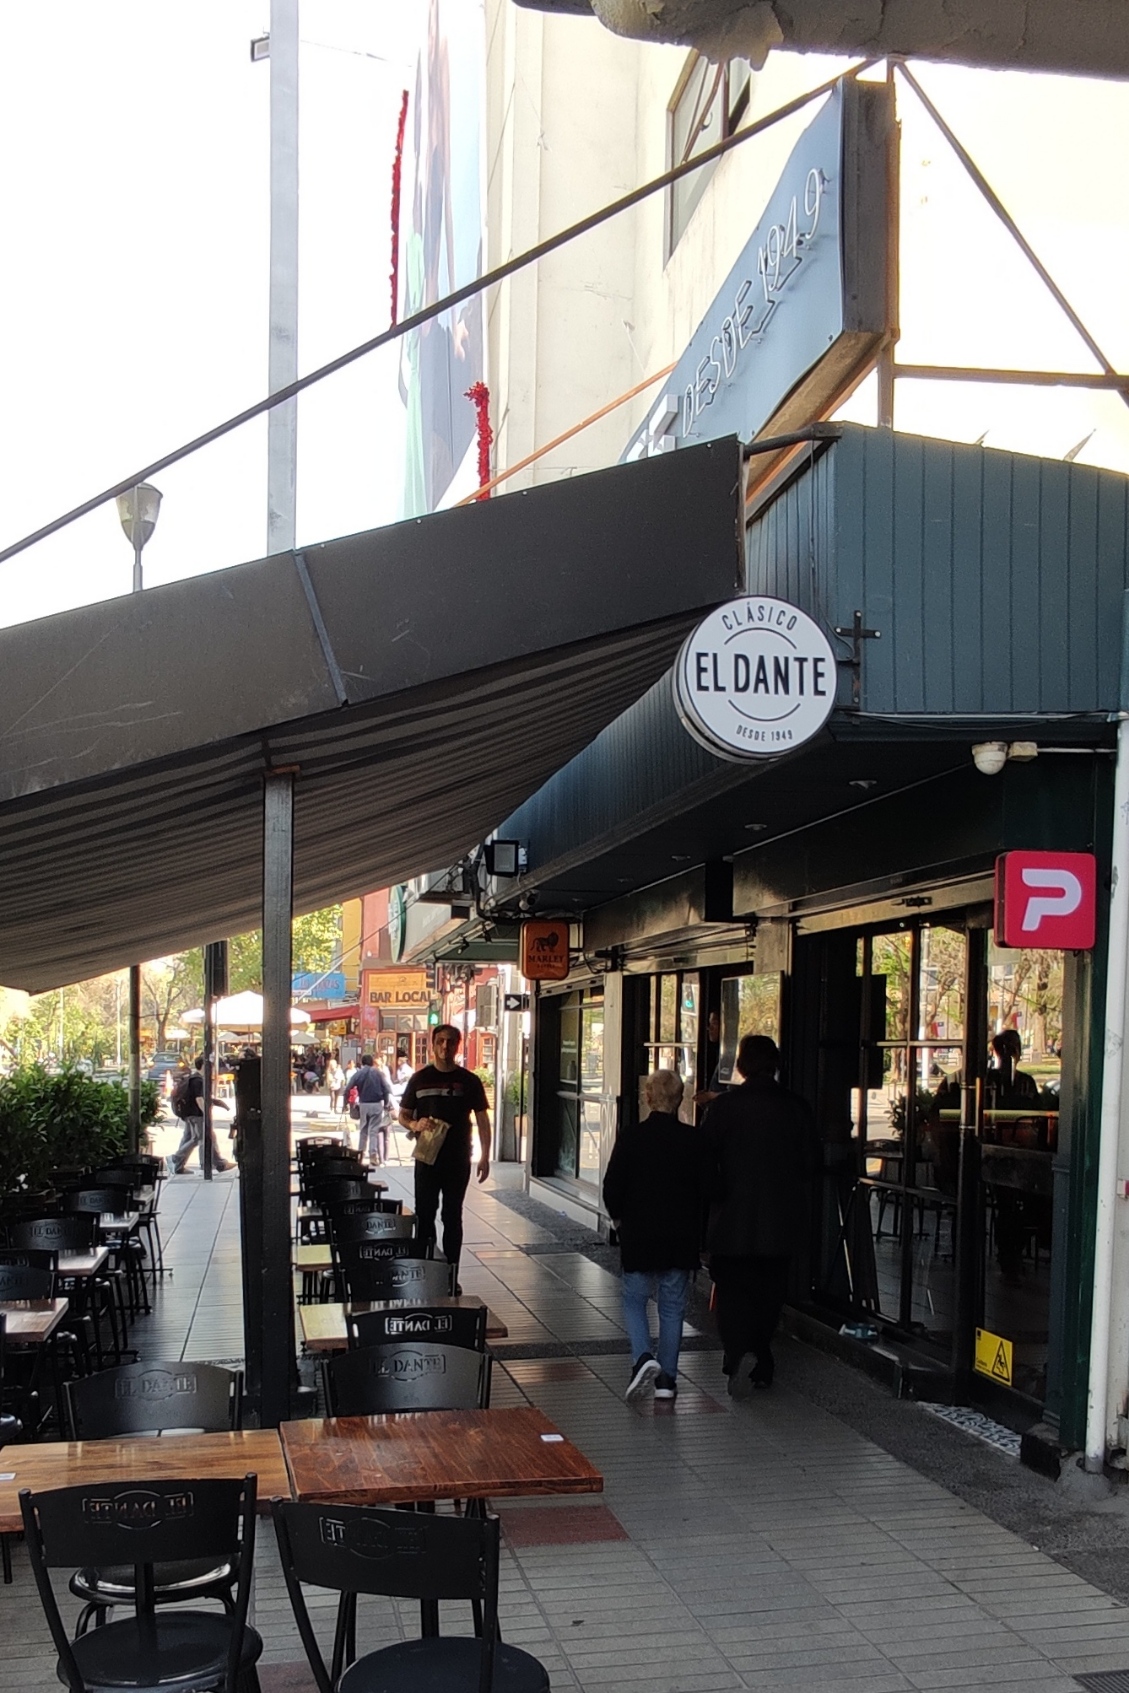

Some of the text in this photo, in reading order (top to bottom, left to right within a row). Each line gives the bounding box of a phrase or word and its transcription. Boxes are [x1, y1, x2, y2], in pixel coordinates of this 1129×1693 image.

[682, 167, 824, 438] DESDE 1949
[721, 601, 798, 631] CLÁSICO
[695, 651, 827, 697] EL DANTE
[736, 724, 793, 741] DESDE 1949
[528, 954, 565, 963] MARLEY
[370, 991, 391, 1004] BAR
